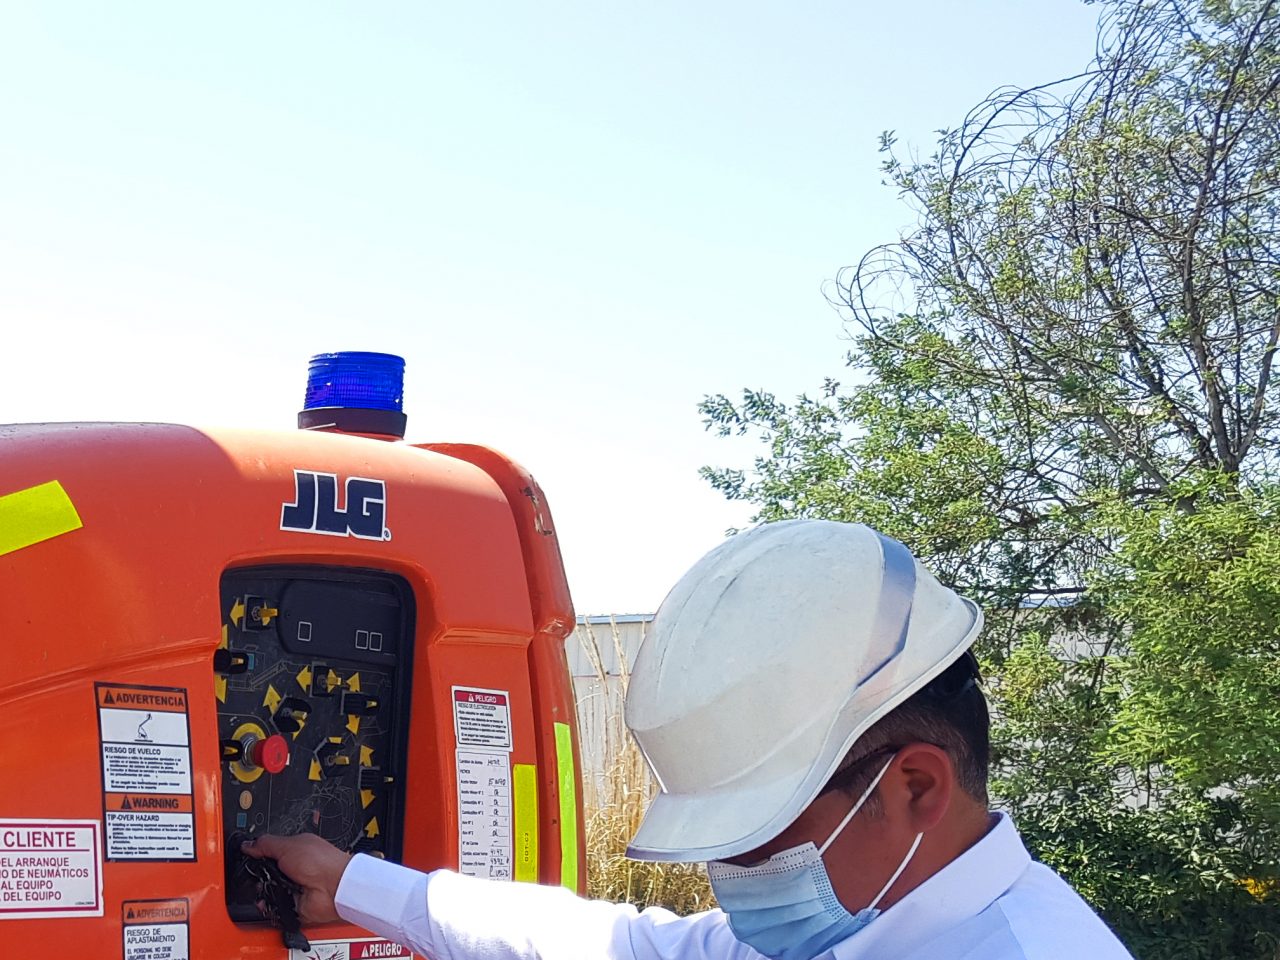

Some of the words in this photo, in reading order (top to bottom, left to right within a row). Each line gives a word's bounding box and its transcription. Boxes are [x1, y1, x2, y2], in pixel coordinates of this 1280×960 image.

[281, 470, 386, 540] JLG
[116, 693, 185, 708] ADVERTENCIA
[104, 746, 127, 754] RIESGO
[132, 797, 180, 809] WARNING
[136, 814, 160, 822] HAZARD
[3, 831, 76, 848] CLIENTE
[15, 857, 69, 867] ARRANQUE
[11, 869, 25, 878] DE
[1, 881, 14, 890] AL
[16, 880, 53, 890] EQUIPO
[3, 892, 23, 902] DEL
[25, 891, 62, 901] EQUIPO
[127, 928, 150, 936] RIESGO
[152, 928, 161, 936] DE
[370, 943, 402, 957] PELIGRO
